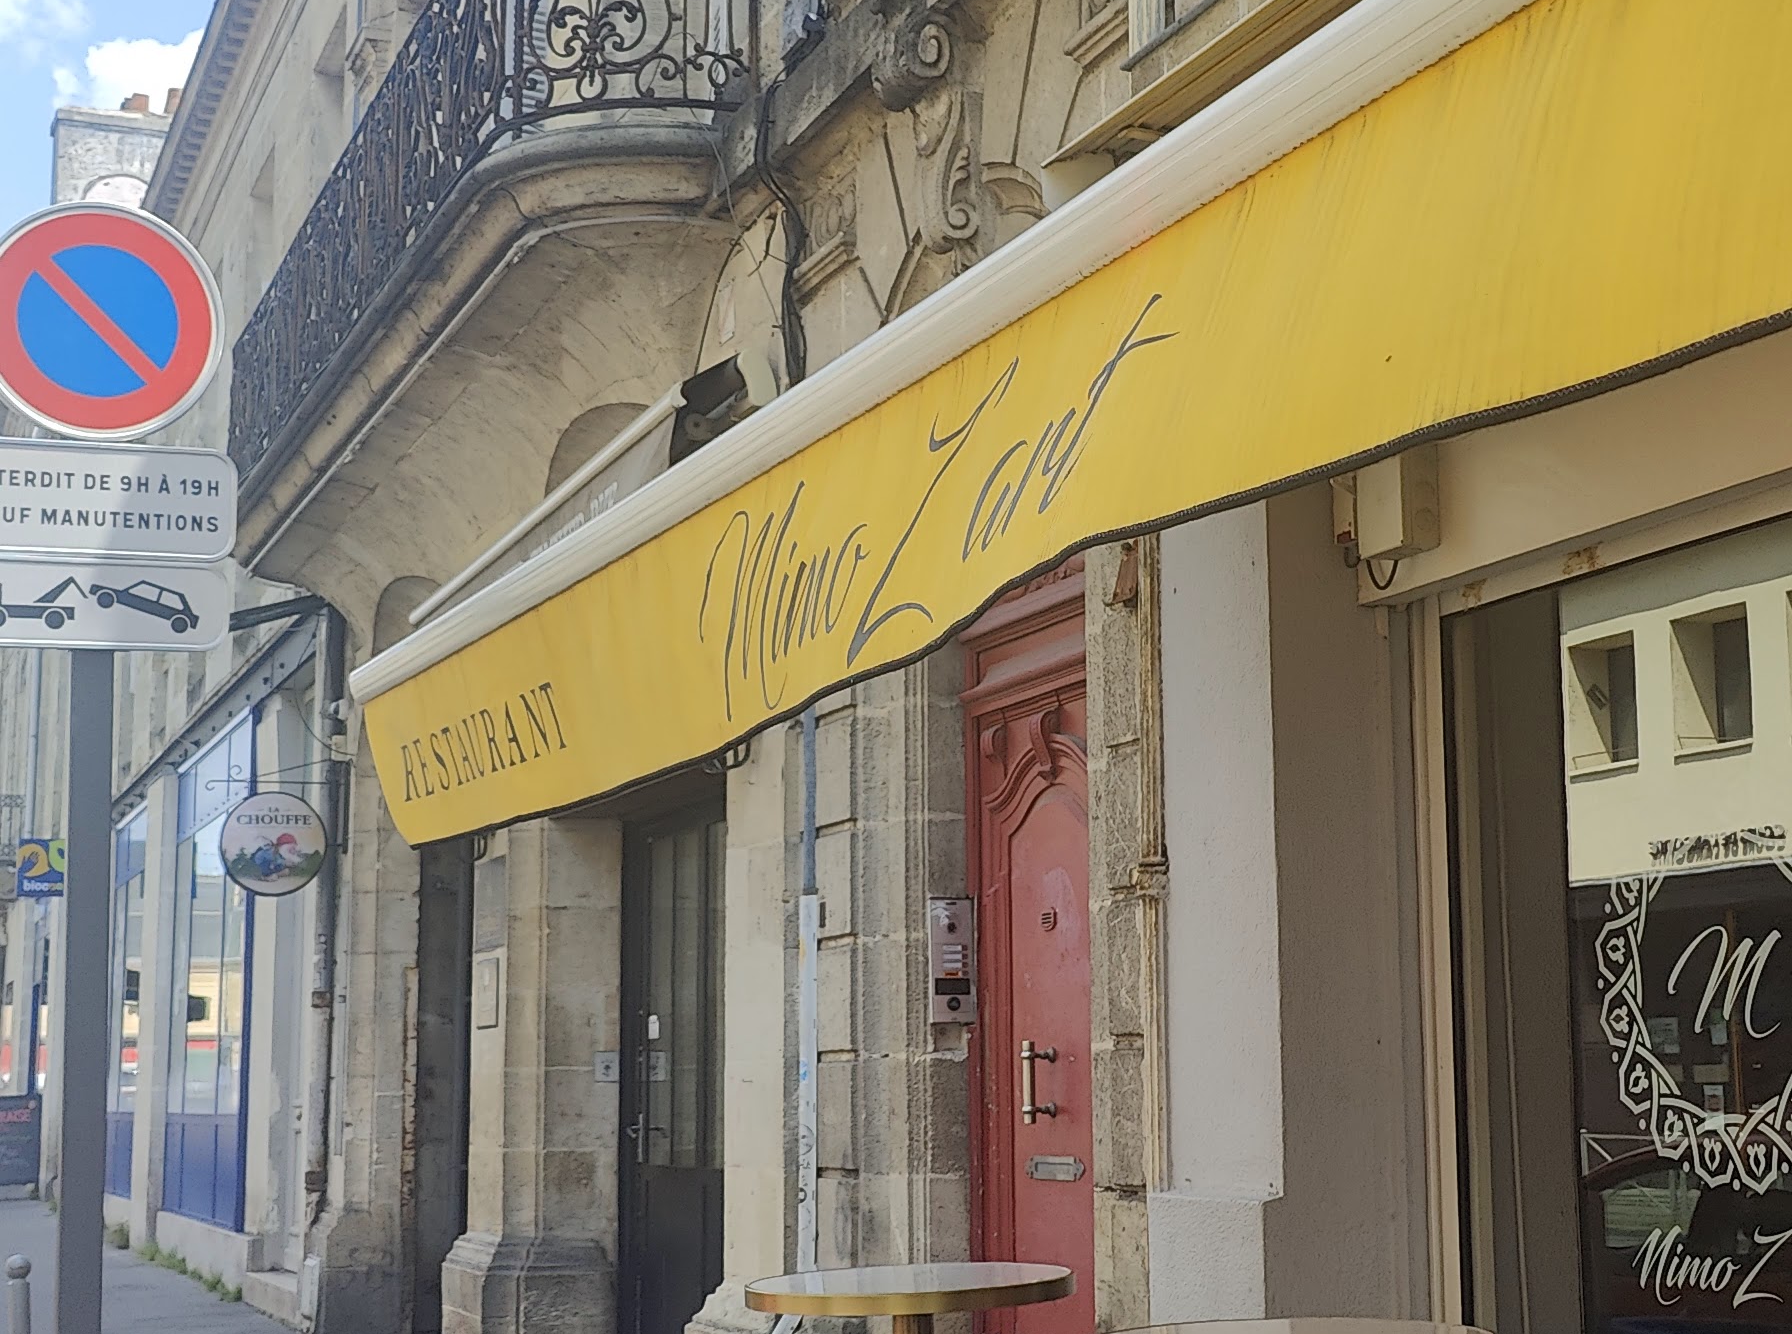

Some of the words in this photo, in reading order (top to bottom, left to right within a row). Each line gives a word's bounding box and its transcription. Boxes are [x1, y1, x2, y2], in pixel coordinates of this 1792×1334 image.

[3, 506, 31, 524] UF
[41, 508, 219, 533] MANUTENTIONS
[84, 473, 111, 491] DE
[120, 475, 149, 494] 9H
[158, 473, 171, 495] À
[180, 479, 219, 497] 19H
[699, 480, 871, 722] Mimo
[401, 682, 567, 802] RESTAURANT
[236, 814, 312, 826] CHOUFFE
[1667, 925, 1782, 1039] M
[1632, 1225, 1742, 1306] Mimo
